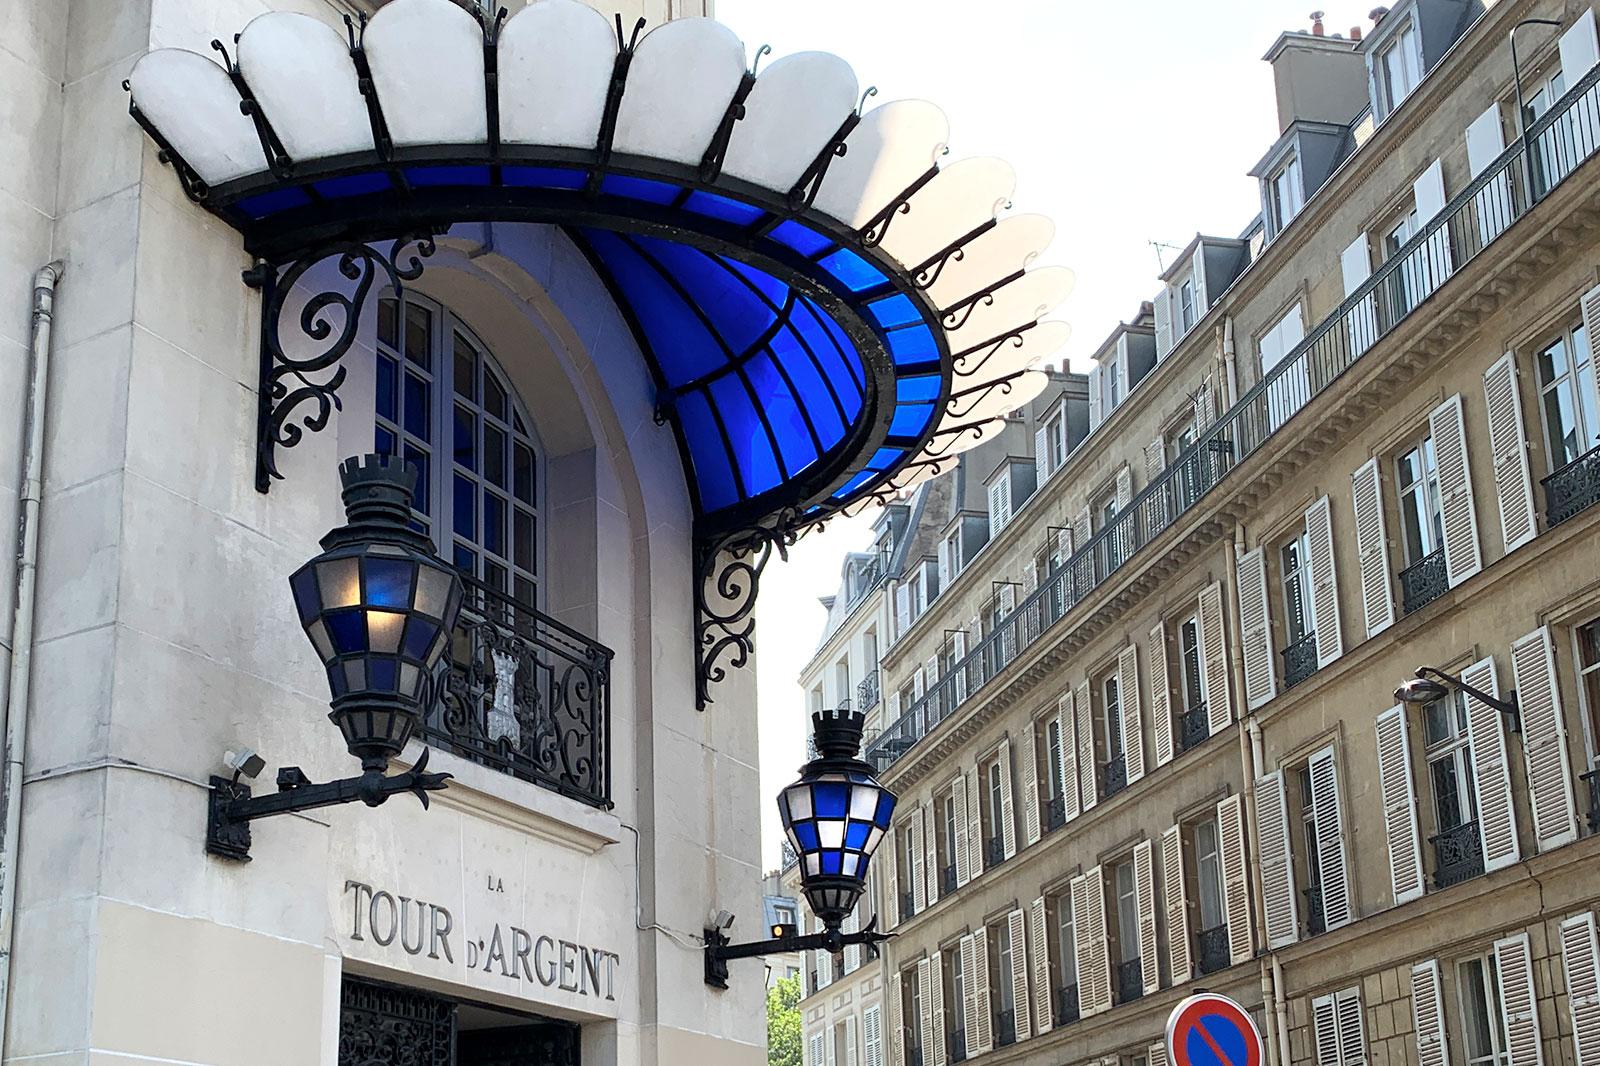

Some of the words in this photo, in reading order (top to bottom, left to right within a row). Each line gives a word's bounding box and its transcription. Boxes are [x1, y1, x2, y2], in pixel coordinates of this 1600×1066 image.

[487, 875, 504, 893] LA
[344, 879, 454, 964] TOUR
[466, 922, 620, 1001] D'ARGENT
